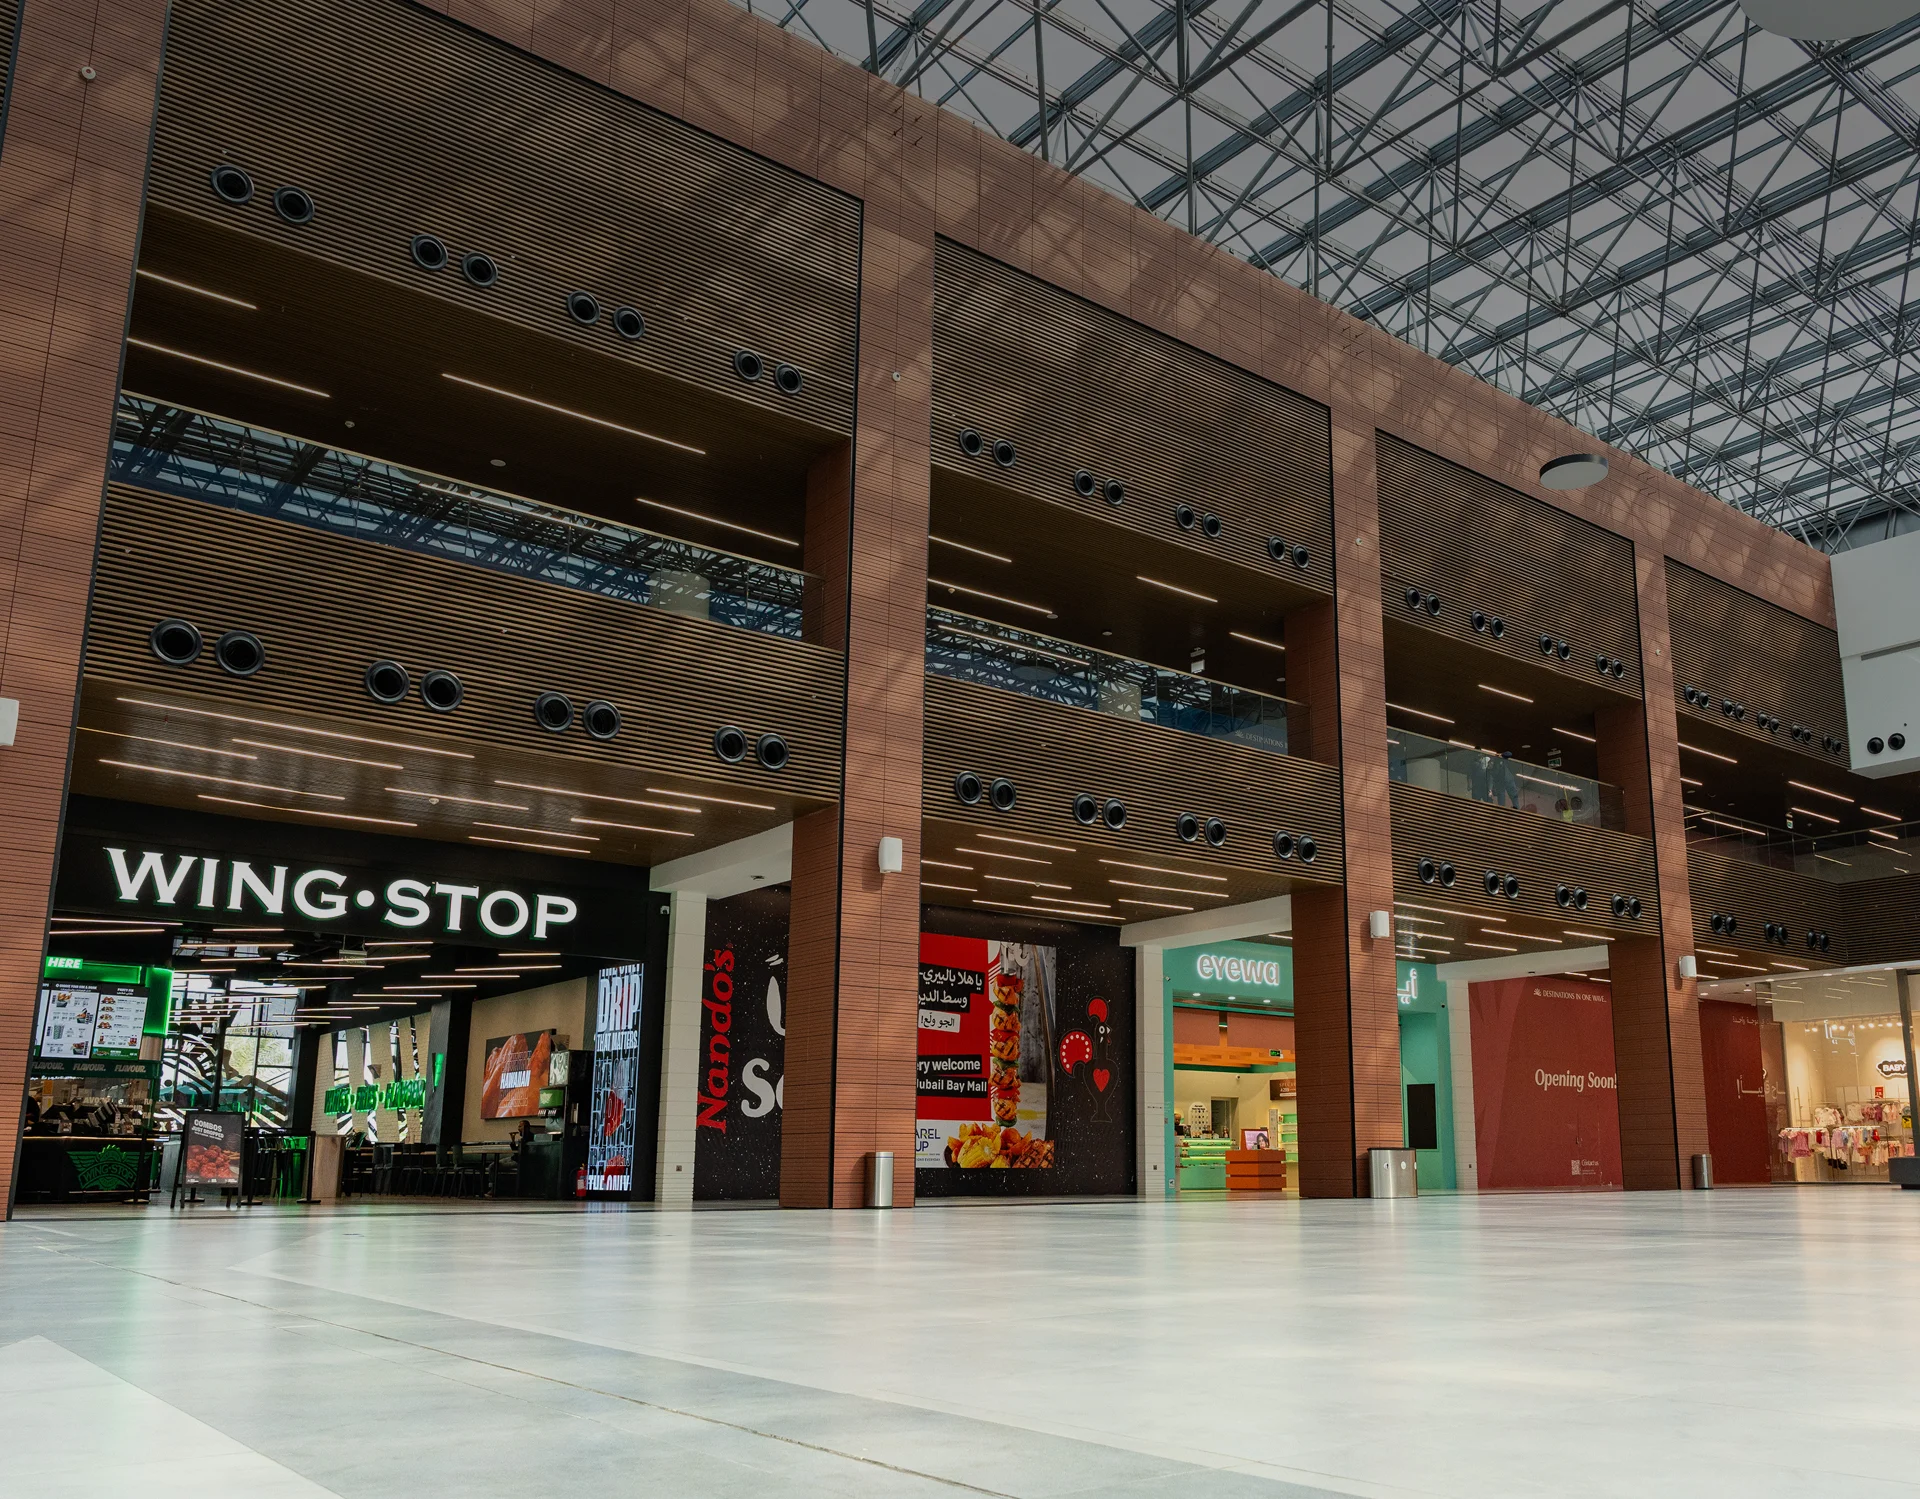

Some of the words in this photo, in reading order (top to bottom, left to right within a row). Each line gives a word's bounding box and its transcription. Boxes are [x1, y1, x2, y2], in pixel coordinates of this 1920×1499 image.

[47, 957, 82, 970] HERE
[1196, 953, 1281, 987] eyewa
[597, 974, 641, 1033] DRIP
[597, 1033, 611, 1052] THAT
[696, 948, 736, 1134] Nando's
[931, 1058, 981, 1071] welcome
[1882, 1063, 1906, 1072] BABY
[946, 1080, 965, 1093] Bay
[967, 1081, 987, 1092] Mall
[1534, 1068, 1584, 1092] Opening
[1587, 1071, 1617, 1089] Soon!
[193, 1118, 223, 1133] COMBOS
[203, 1128, 225, 1139] DROPPED
